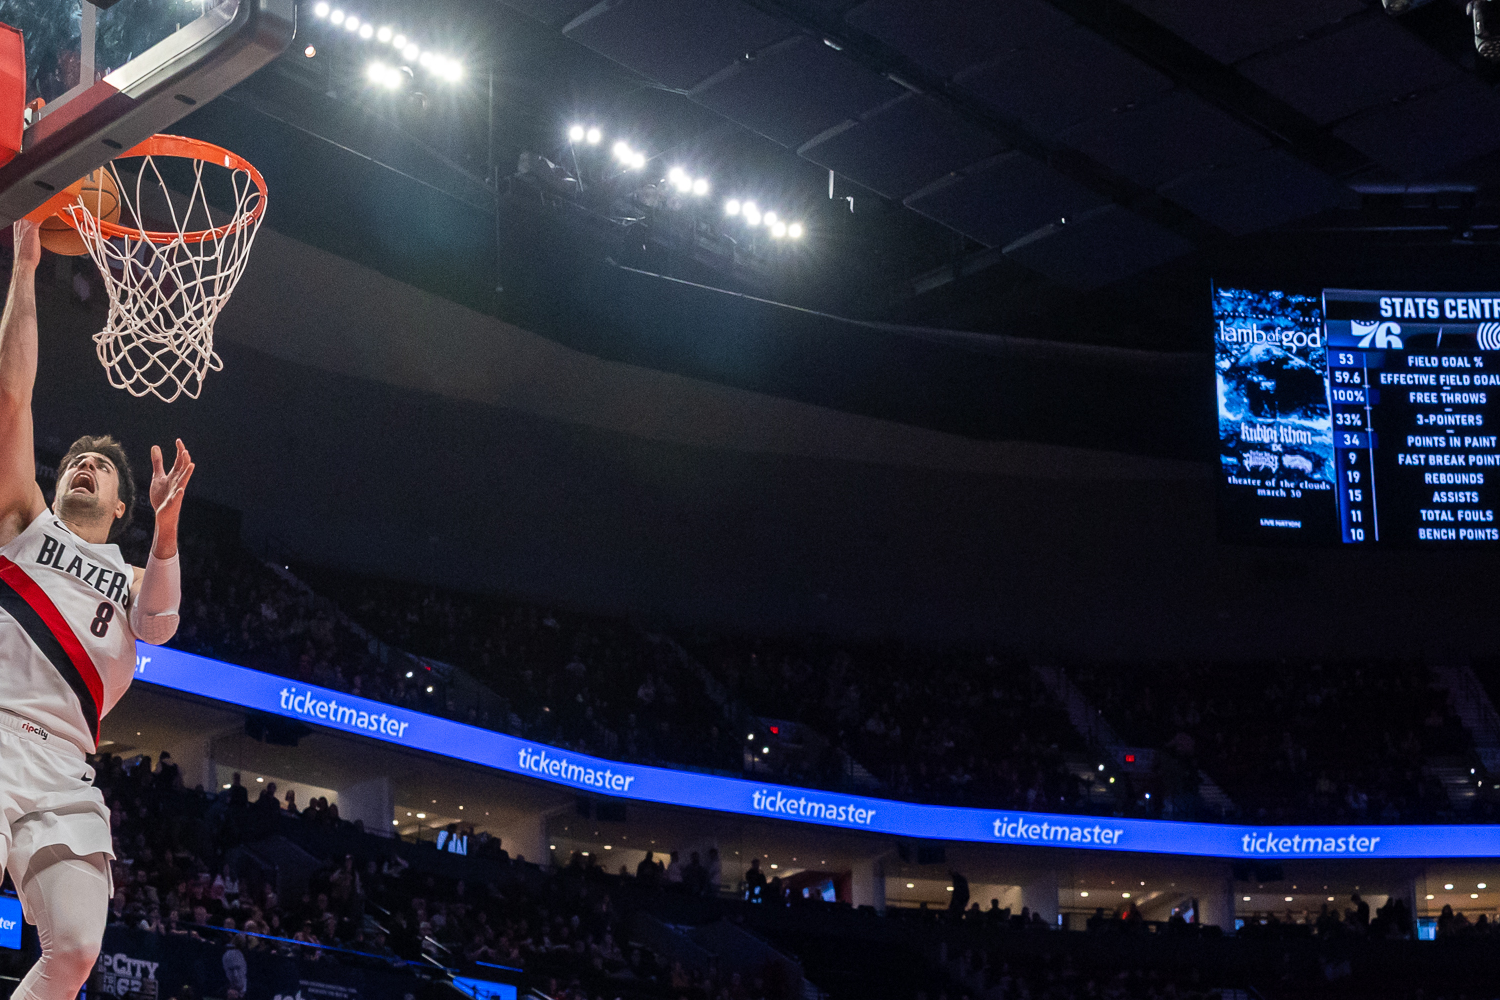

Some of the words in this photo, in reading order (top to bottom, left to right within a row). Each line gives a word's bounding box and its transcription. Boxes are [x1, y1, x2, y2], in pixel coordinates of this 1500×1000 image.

[1380, 297, 1440, 319] STATS
[1220, 320, 1266, 344] lamb
[1281, 327, 1321, 354] god
[1339, 353, 1354, 365] 53
[1408, 355, 1439, 368] FIELD
[1441, 356, 1471, 368] GOAL
[1335, 371, 1361, 384] 59.6
[1380, 373, 1437, 385] EFFECTIVE
[1439, 374, 1471, 386] FIELD
[1333, 389, 1365, 402] 100%
[1409, 391, 1438, 404] FREE
[1440, 392, 1487, 404] THROWS
[1336, 413, 1362, 426] 33%
[1416, 413, 1483, 426] 3-POINTERS
[1343, 433, 1360, 446] 34
[1407, 435, 1447, 448] POINTS
[1449, 436, 1461, 448] IN
[1464, 436, 1497, 448] PAINT
[1348, 452, 1357, 465] 9
[1398, 453, 1426, 466] FAST
[1428, 454, 1466, 466] BREAK
[1227, 476, 1261, 486] theater
[1265, 477, 1276, 488] of
[1280, 479, 1295, 489] the
[1299, 480, 1331, 490] clouds
[1347, 470, 1360, 483] 19
[1424, 473, 1484, 485] REBOUNDS
[1257, 488, 1287, 498] march
[1348, 489, 1362, 502] 15
[1433, 491, 1479, 503] ASSISTS
[1350, 509, 1362, 523] 11
[1420, 510, 1454, 522] TOTAL
[1457, 510, 1494, 522] FOULS
[1350, 528, 1365, 541] 10
[1418, 528, 1456, 540] BENCH
[1460, 528, 1499, 541] POINTS
[90, 601, 115, 638] 8
[279, 687, 409, 738] ticketmaster
[518, 747, 634, 791] ticketmaster
[752, 789, 876, 826] ticketmaster
[992, 817, 1123, 845] ticketmaster
[1241, 832, 1380, 853] ticketmaster
